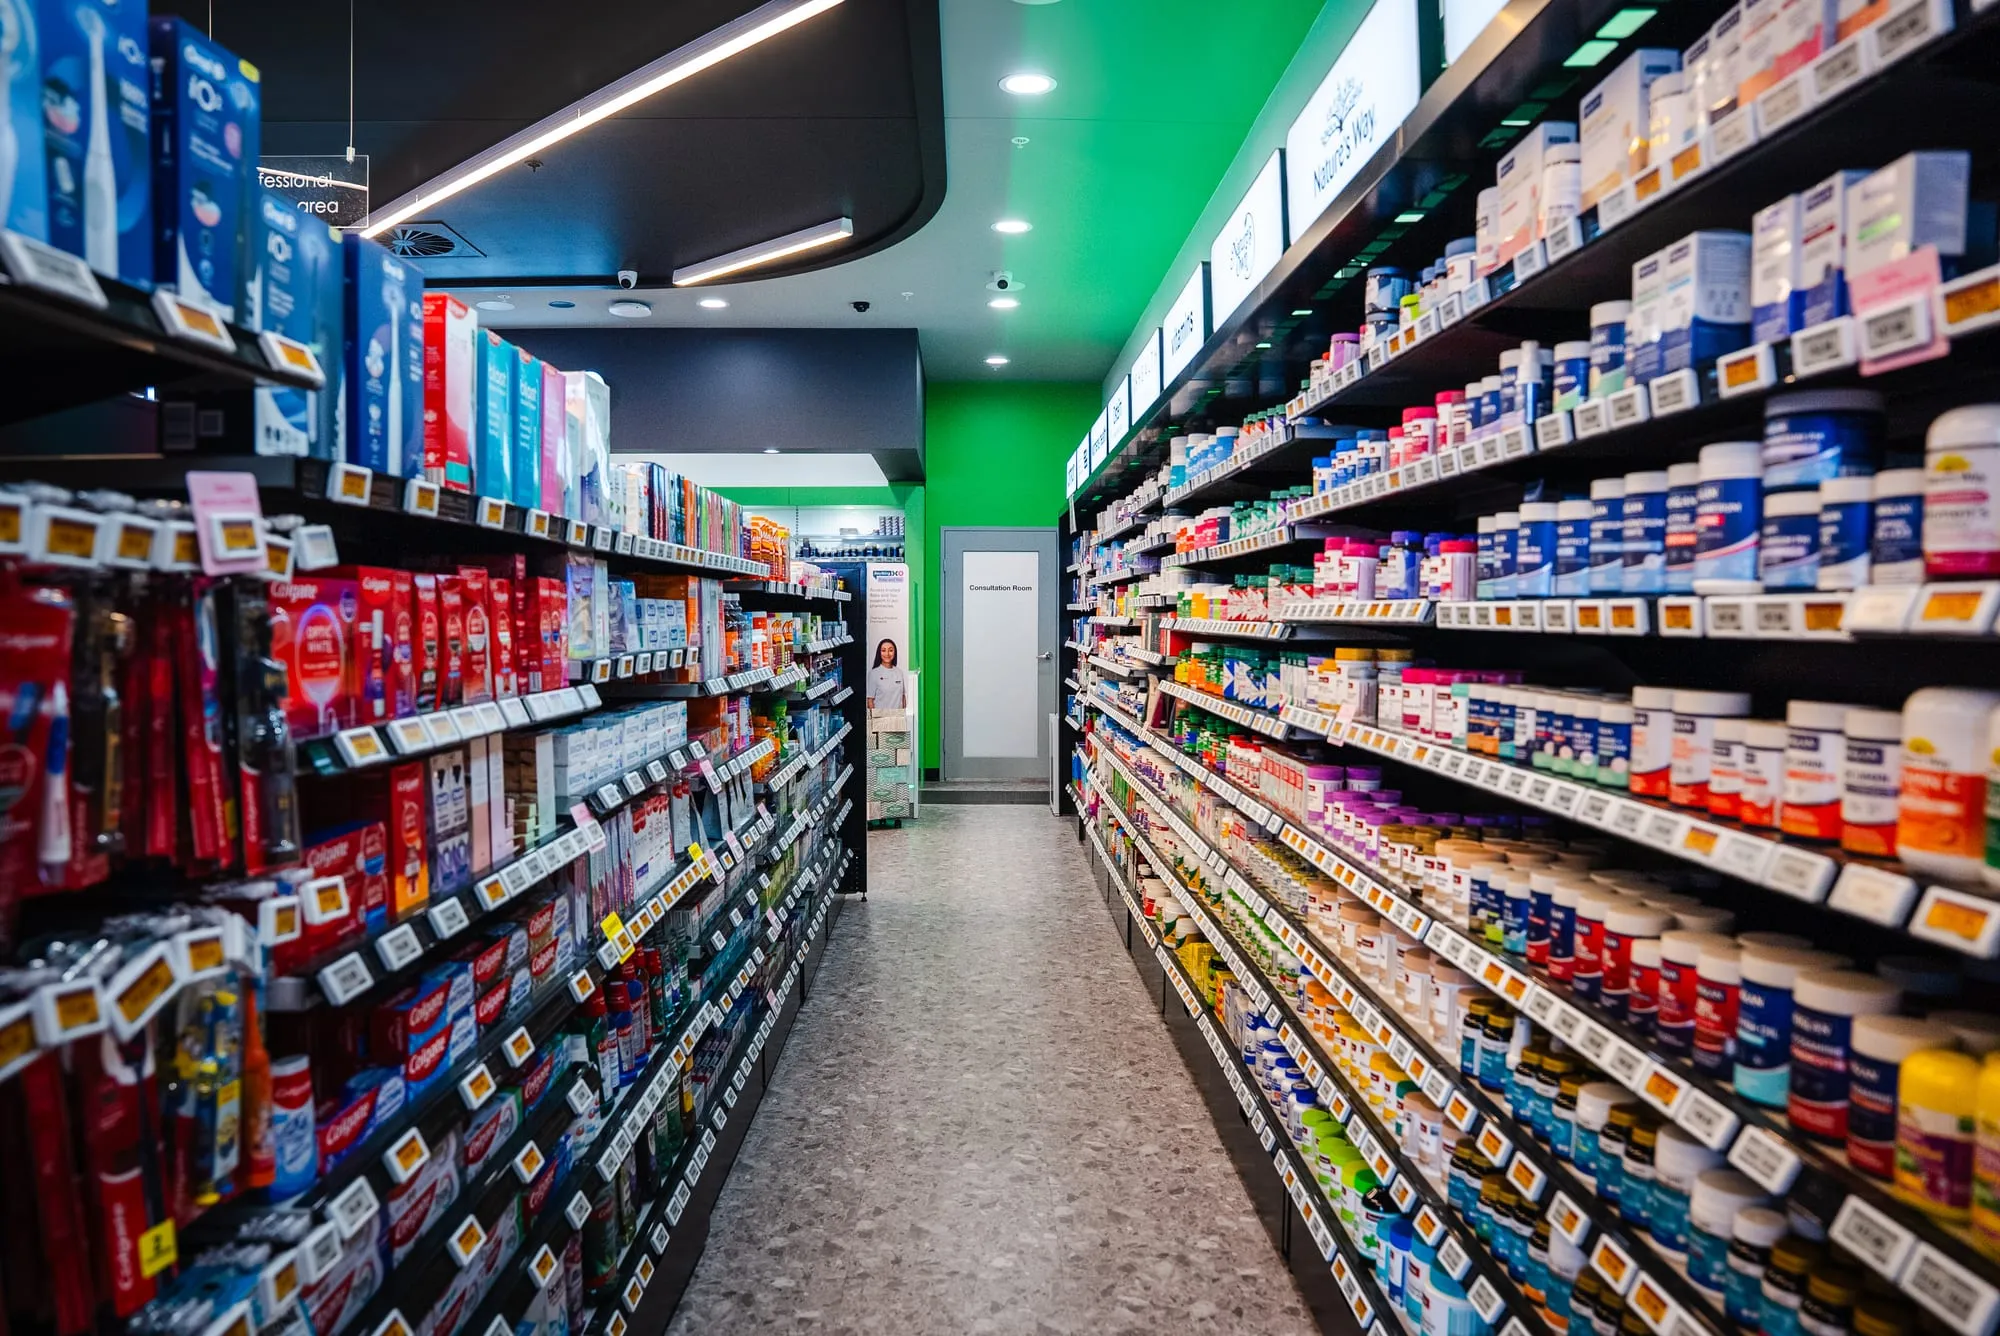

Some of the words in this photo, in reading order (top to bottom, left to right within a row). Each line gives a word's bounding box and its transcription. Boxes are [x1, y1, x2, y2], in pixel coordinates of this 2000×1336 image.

[1313, 136, 1352, 199] Nature's
[1352, 103, 1376, 150] Way
[297, 200, 339, 213] area
[969, 584, 1011, 592] Consultation
[1012, 584, 1033, 592] Room
[307, 842, 349, 869] Colgate
[529, 910, 552, 936] Colgate
[475, 947, 504, 977] Colgate
[532, 944, 555, 973] Colgate
[409, 991, 445, 1027] Colgate
[478, 983, 507, 1018] Colgate
[408, 1036, 447, 1075] Colgate
[326, 1101, 370, 1146] Colgate
